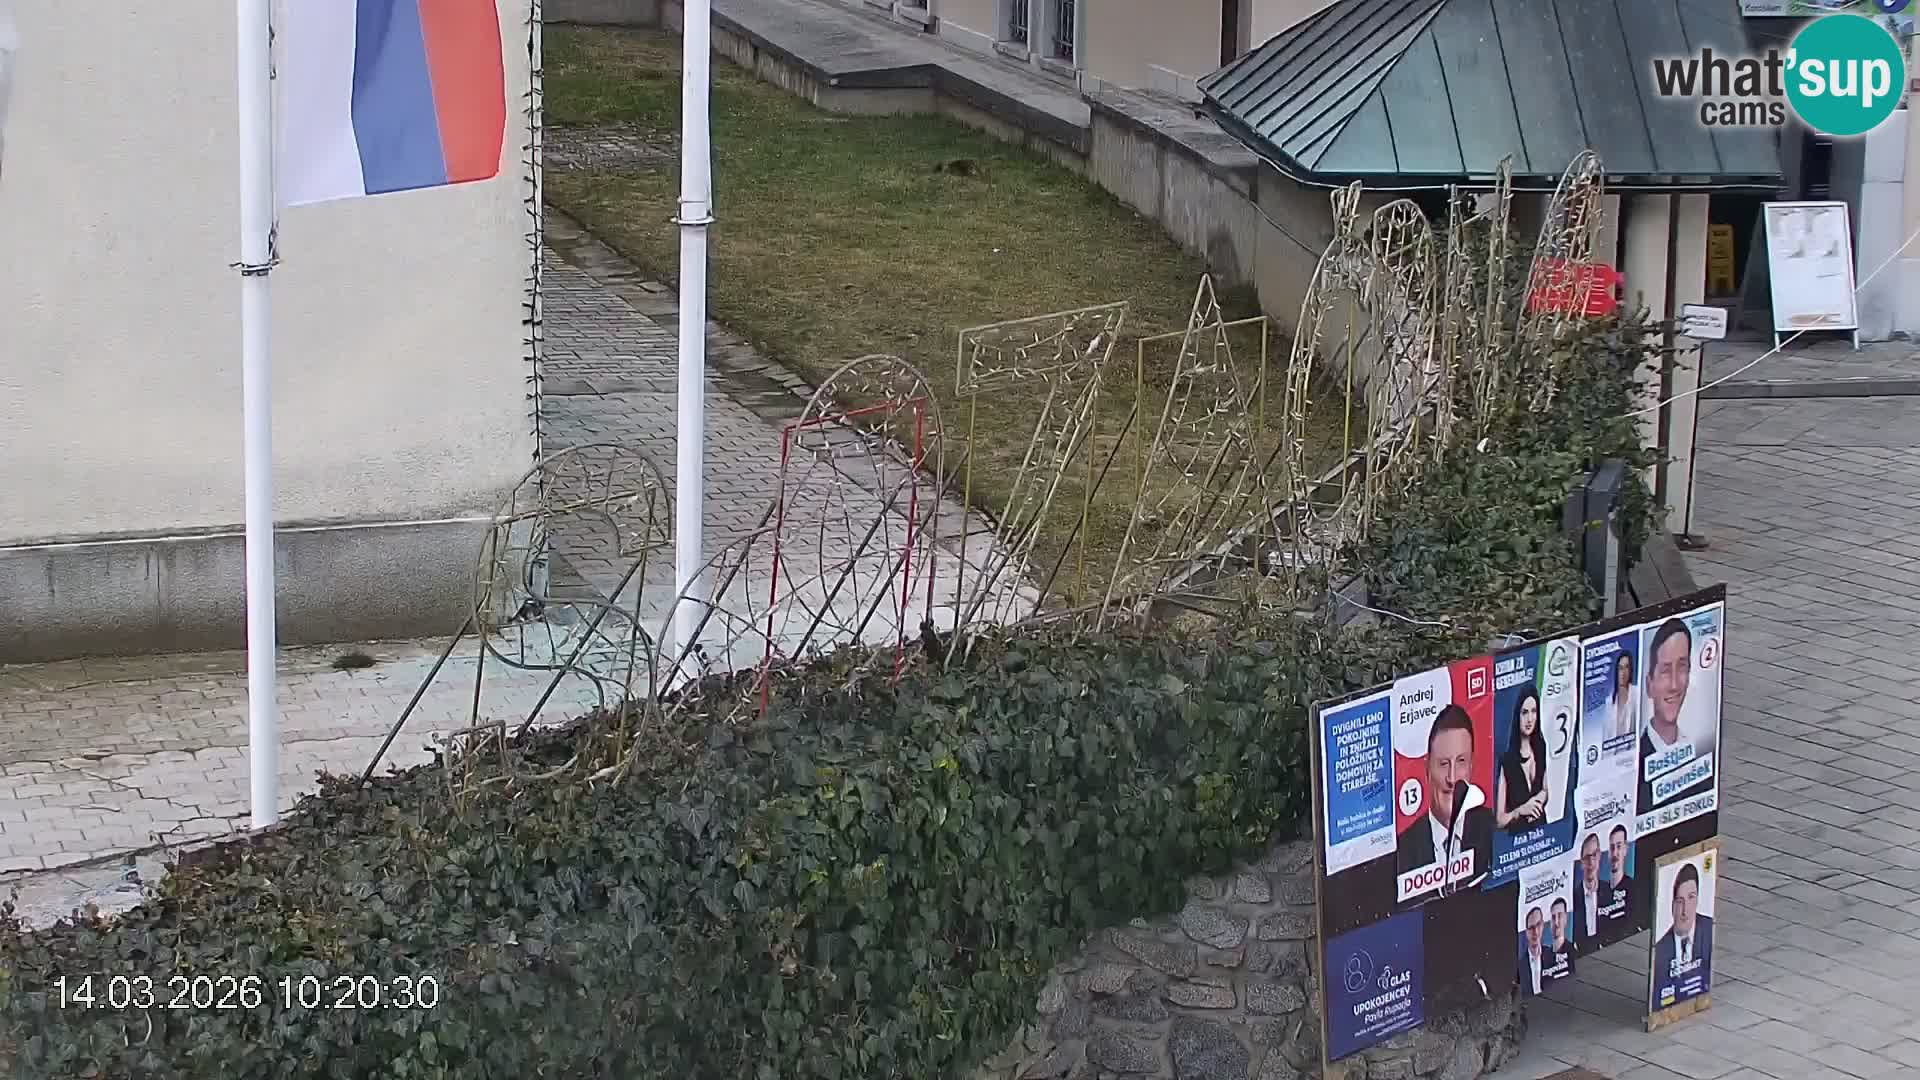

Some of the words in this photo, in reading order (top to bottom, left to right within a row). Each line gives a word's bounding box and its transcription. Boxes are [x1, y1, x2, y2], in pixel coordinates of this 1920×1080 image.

[1705, 646, 1713, 661] 2
[1471, 677, 1483, 689] SD
[1400, 684, 1434, 707] Andrej
[1332, 716, 1365, 736] DVIGNILI
[1366, 711, 1384, 725] SMO
[1400, 705, 1437, 724] Erjavec
[1336, 723, 1380, 747] POKOJNINE
[1555, 712, 1569, 755] 3
[1335, 748, 1377, 772] POLOŽNICE
[1378, 746, 1384, 757] V
[1340, 746, 1348, 758] IN
[1349, 736, 1378, 753] ZNIŽALI
[1336, 763, 1373, 784] DOMOVIH
[1373, 758, 1384, 771] ZA
[1647, 744, 1693, 775] Boštjan
[1404, 787, 1418, 806] 13
[1662, 807, 1680, 824] SLS
[1683, 795, 1714, 817] FOKUS
[1390, 970, 1411, 987] GLAS
[1353, 984, 1411, 1016] UPOKOJENCEV
